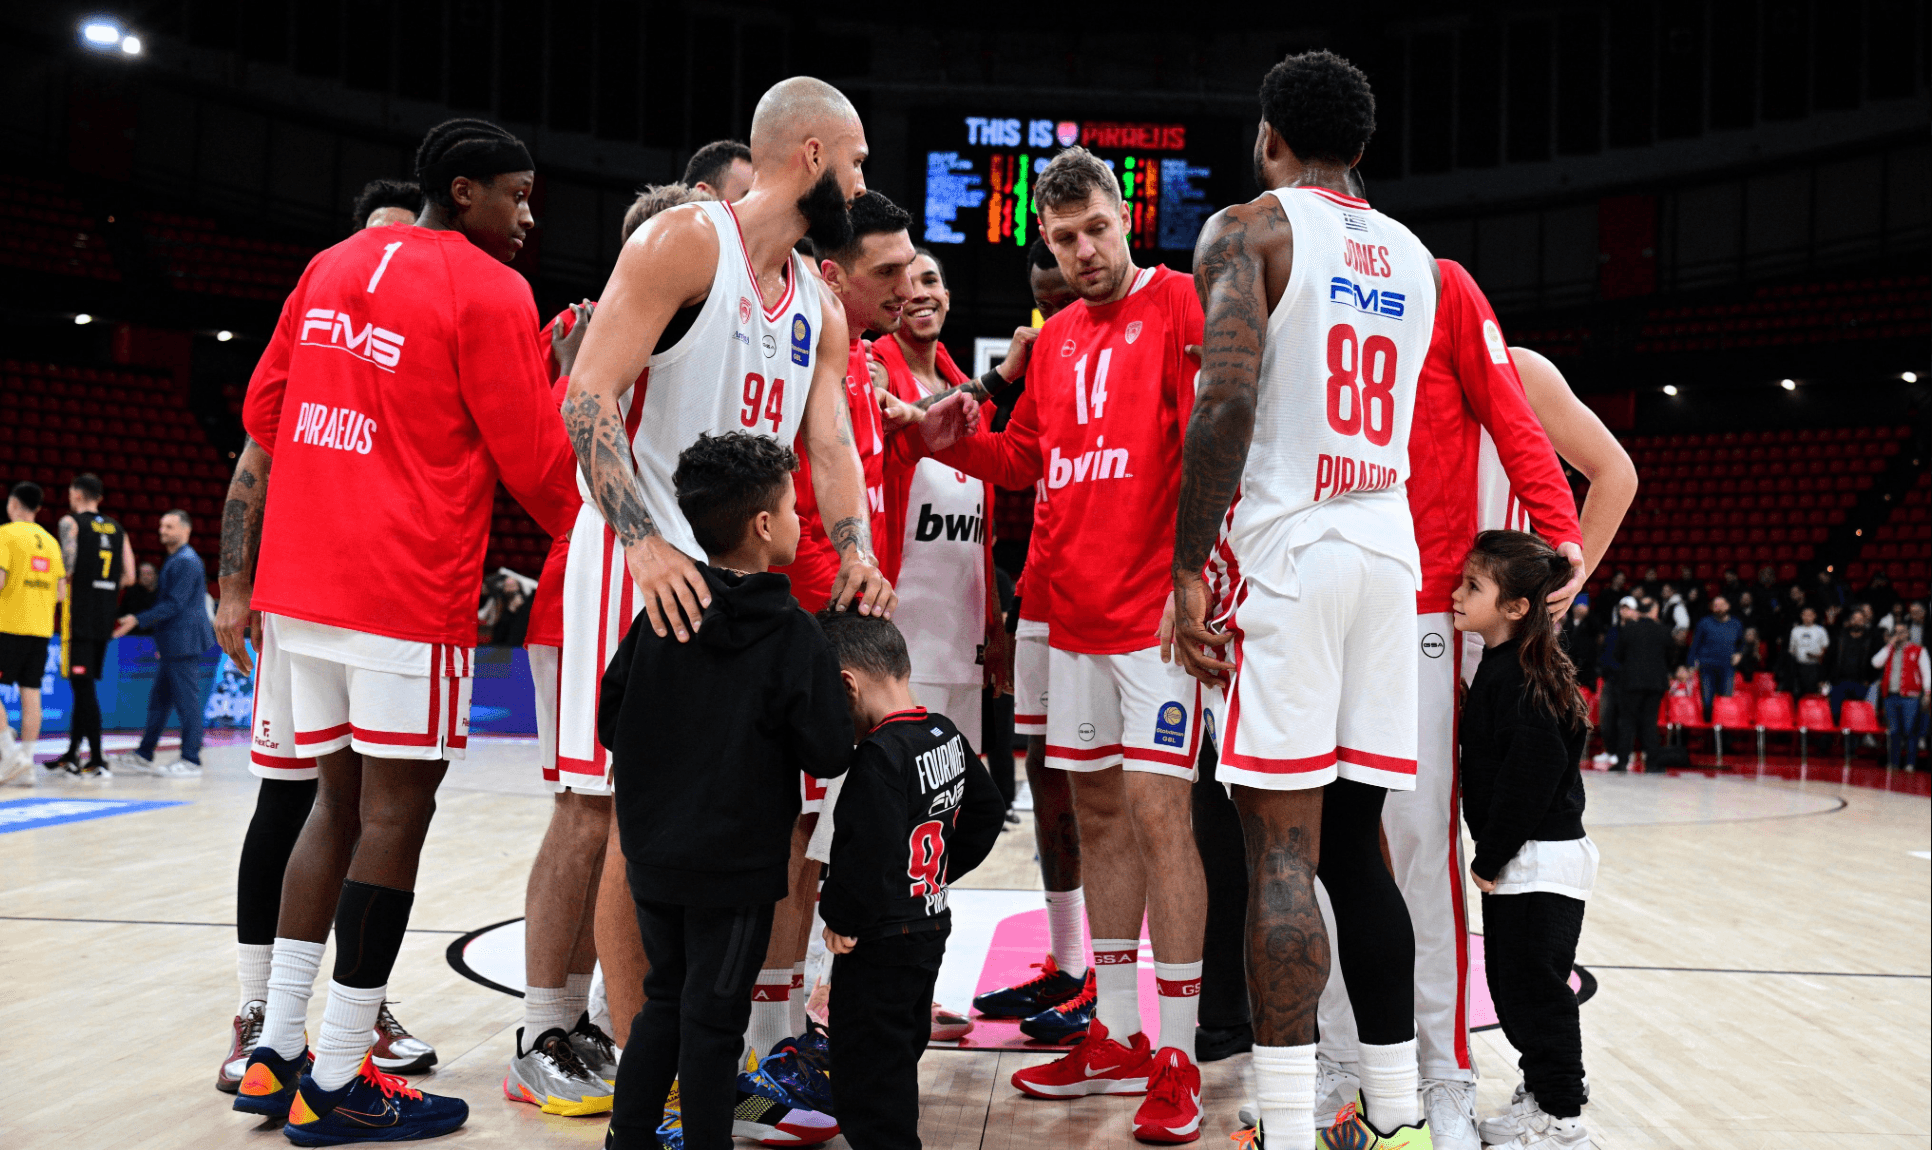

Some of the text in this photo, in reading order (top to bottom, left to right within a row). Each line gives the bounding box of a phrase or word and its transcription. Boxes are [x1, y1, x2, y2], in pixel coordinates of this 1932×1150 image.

[966, 117, 1021, 147] THIS
[1028, 119, 1053, 148] IS
[367, 242, 403, 293] 1
[1343, 236, 1391, 278] JONES
[1330, 277, 1405, 320] FMS
[301, 308, 405, 372] FMS
[741, 372, 785, 433] 94
[1074, 348, 1112, 425] 14
[1326, 323, 1397, 446] 88
[293, 402, 377, 454] PIRAEUS
[99, 550, 113, 578] 7
[915, 734, 966, 794] FOURNIE
[924, 888, 948, 916] PIRA
[1094, 954, 1132, 964] GSA
[1182, 982, 1200, 995] GS
